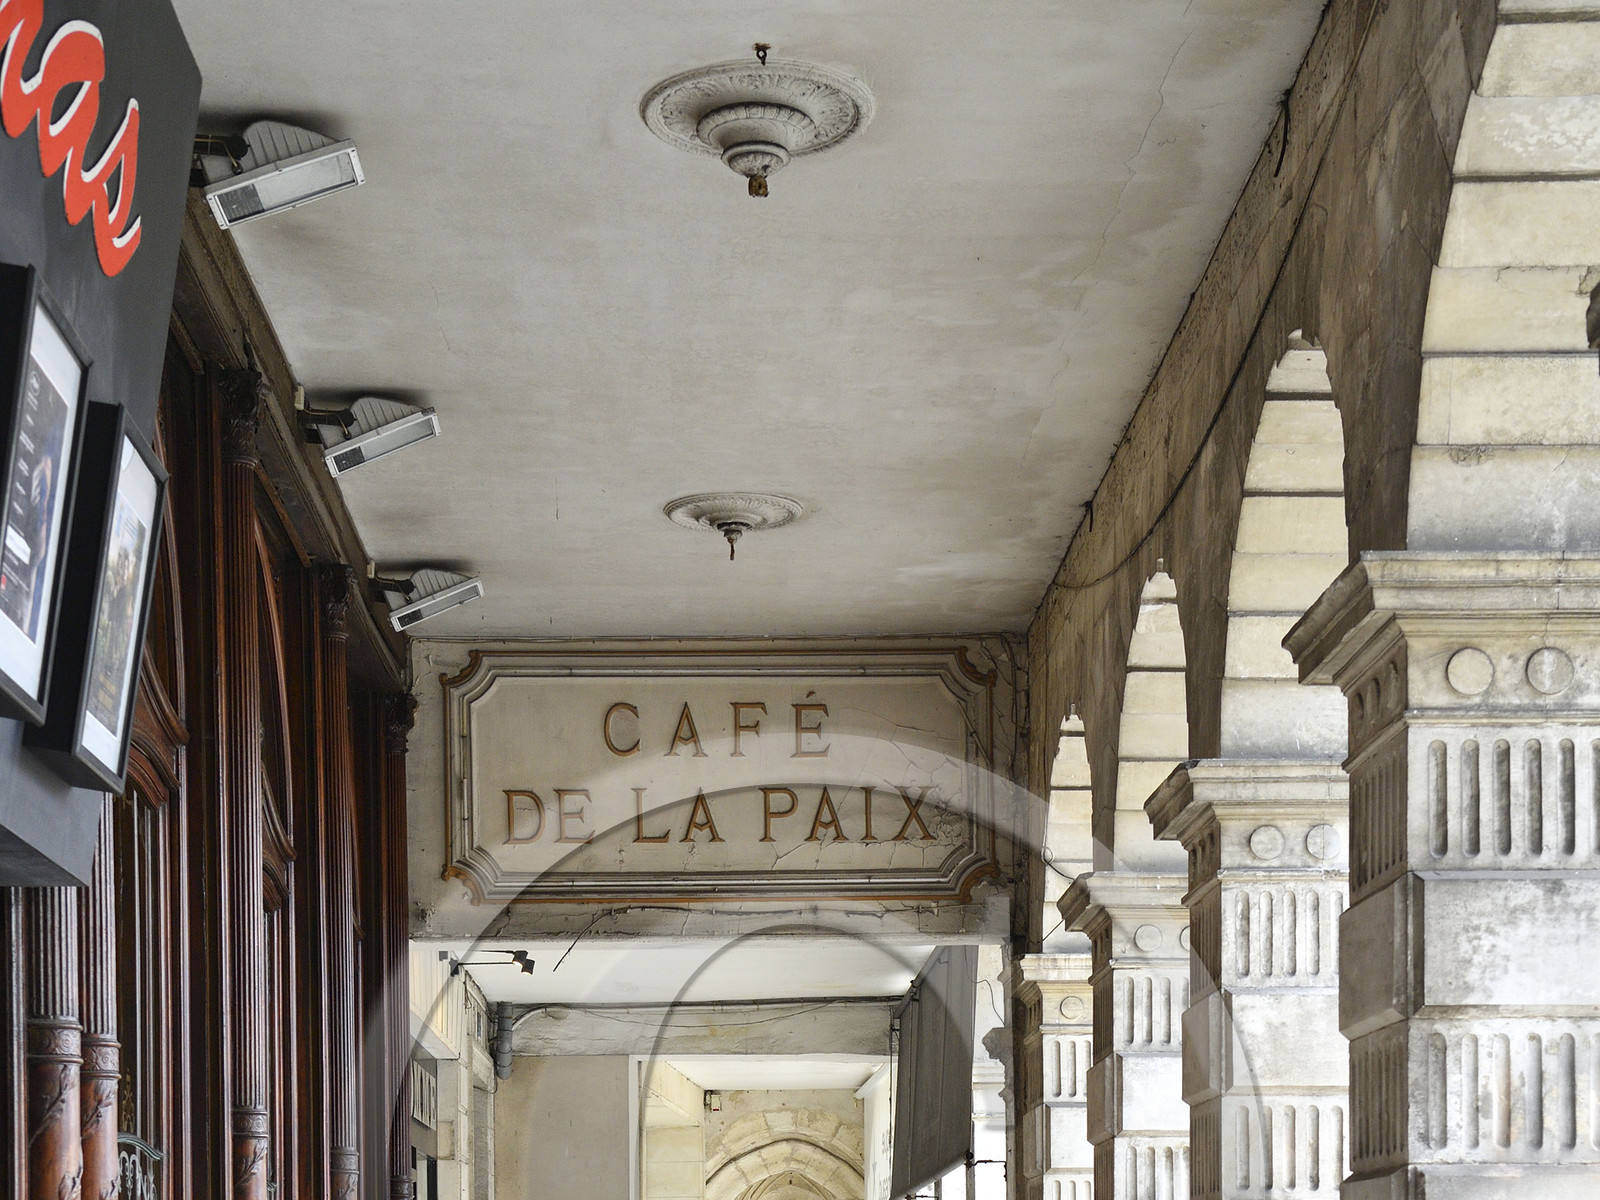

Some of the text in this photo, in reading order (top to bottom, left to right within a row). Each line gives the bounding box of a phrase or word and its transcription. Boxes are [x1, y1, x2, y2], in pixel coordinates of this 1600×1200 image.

[603, 690, 832, 758] CAFÉ
[502, 785, 938, 845] DE LA PAIX
